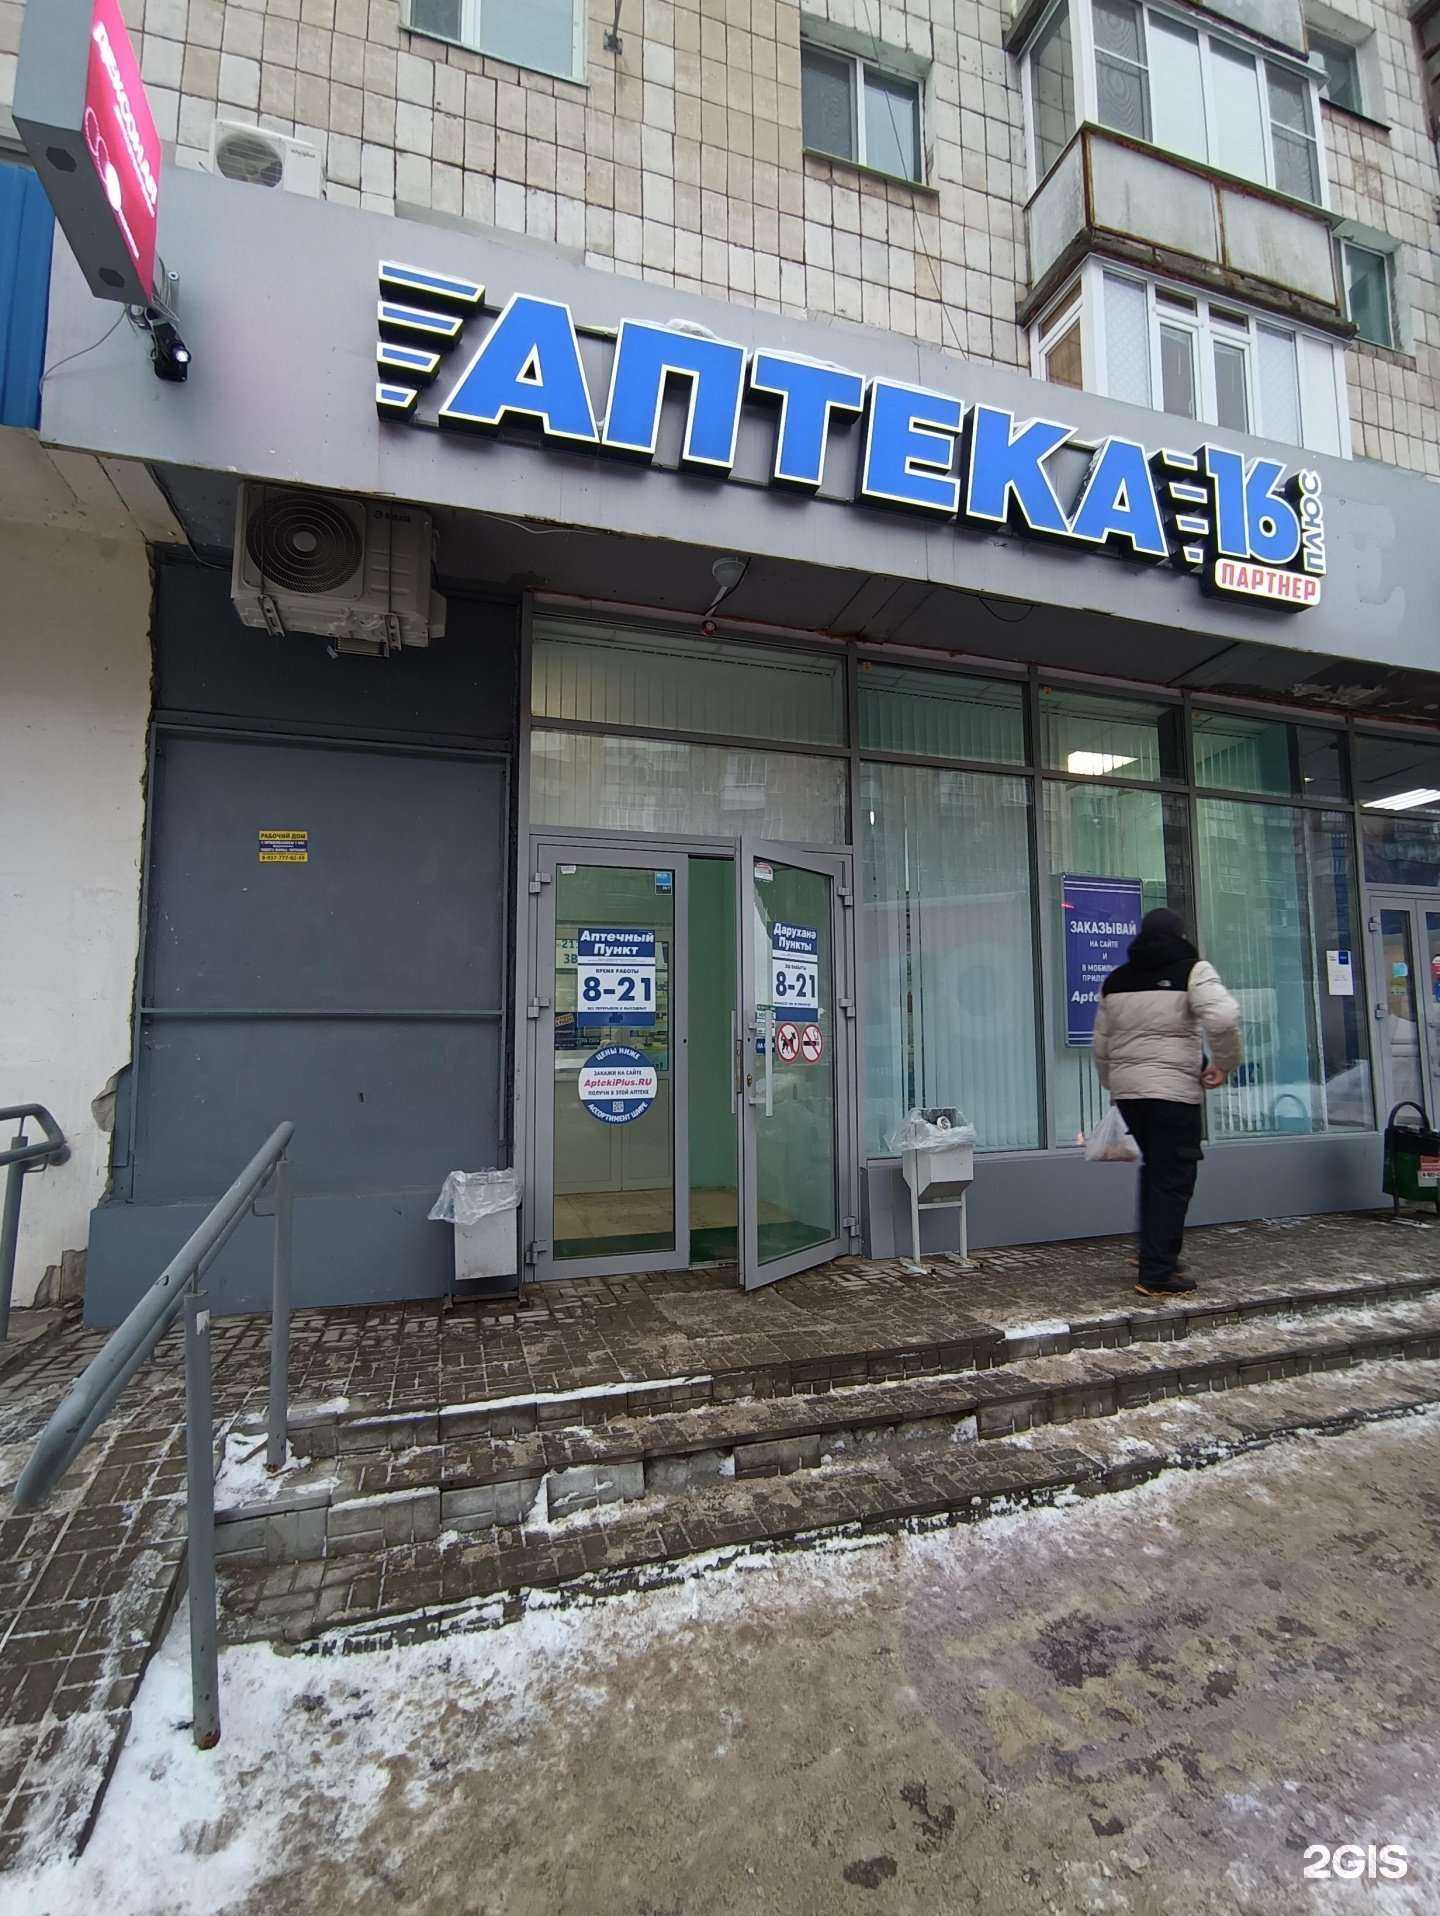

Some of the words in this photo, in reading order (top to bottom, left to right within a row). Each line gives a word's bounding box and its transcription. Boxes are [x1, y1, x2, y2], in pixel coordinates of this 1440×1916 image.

[439, 293, 1169, 558] АПТЕКА
[1205, 442, 1301, 565] 16
[1299, 469, 1327, 575] ПЛЮС
[1221, 562, 1317, 601] ПАРТНЕР
[1070, 920, 1137, 936] ЗАКАЗЫВАЙ
[580, 930, 655, 943] Аптечный
[1089, 940, 1098, 948] НА
[1099, 939, 1119, 949] САЙТЕ
[593, 943, 639, 957] Пункт
[779, 937, 812, 952] Пункты
[1102, 952, 1108, 960] И
[583, 976, 652, 1002] 8-21
[776, 971, 816, 998] 8-21
[595, 1047, 617, 1060] ЦЕНЫ
[619, 1047, 641, 1060] НИЖЕ
[584, 1078, 653, 1088] AptekiPlus.RU
[588, 1103, 631, 1122] АССОРТИМЕНТ
